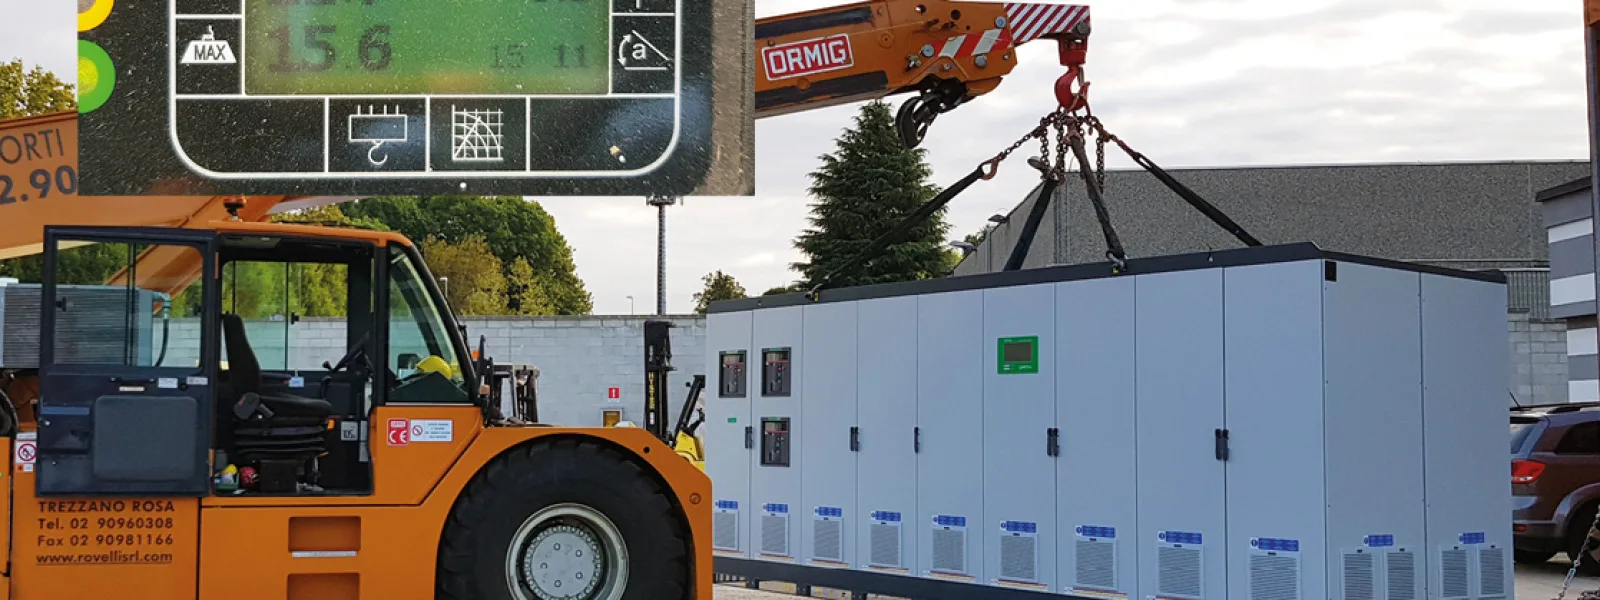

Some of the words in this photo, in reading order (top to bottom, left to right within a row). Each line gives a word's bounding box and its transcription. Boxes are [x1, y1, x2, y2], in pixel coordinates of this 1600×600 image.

[193, 44, 227, 61] MAX
[266, 25, 393, 73] 15.6
[768, 38, 847, 73] ORMIG
[0, 128, 64, 164] ORTI
[0, 165, 77, 204] 2.90
[389, 430, 408, 443] CE
[39, 501, 125, 512] TREZZANO
[132, 501, 175, 512] ROSA
[38, 519, 64, 530] Tel.
[70, 519, 88, 529] 02
[97, 518, 173, 529] 90960308
[37, 536, 64, 547] Fax
[70, 536, 88, 546] 02
[96, 535, 173, 546] 90981166
[36, 551, 172, 565] www.rovellisrl.com
